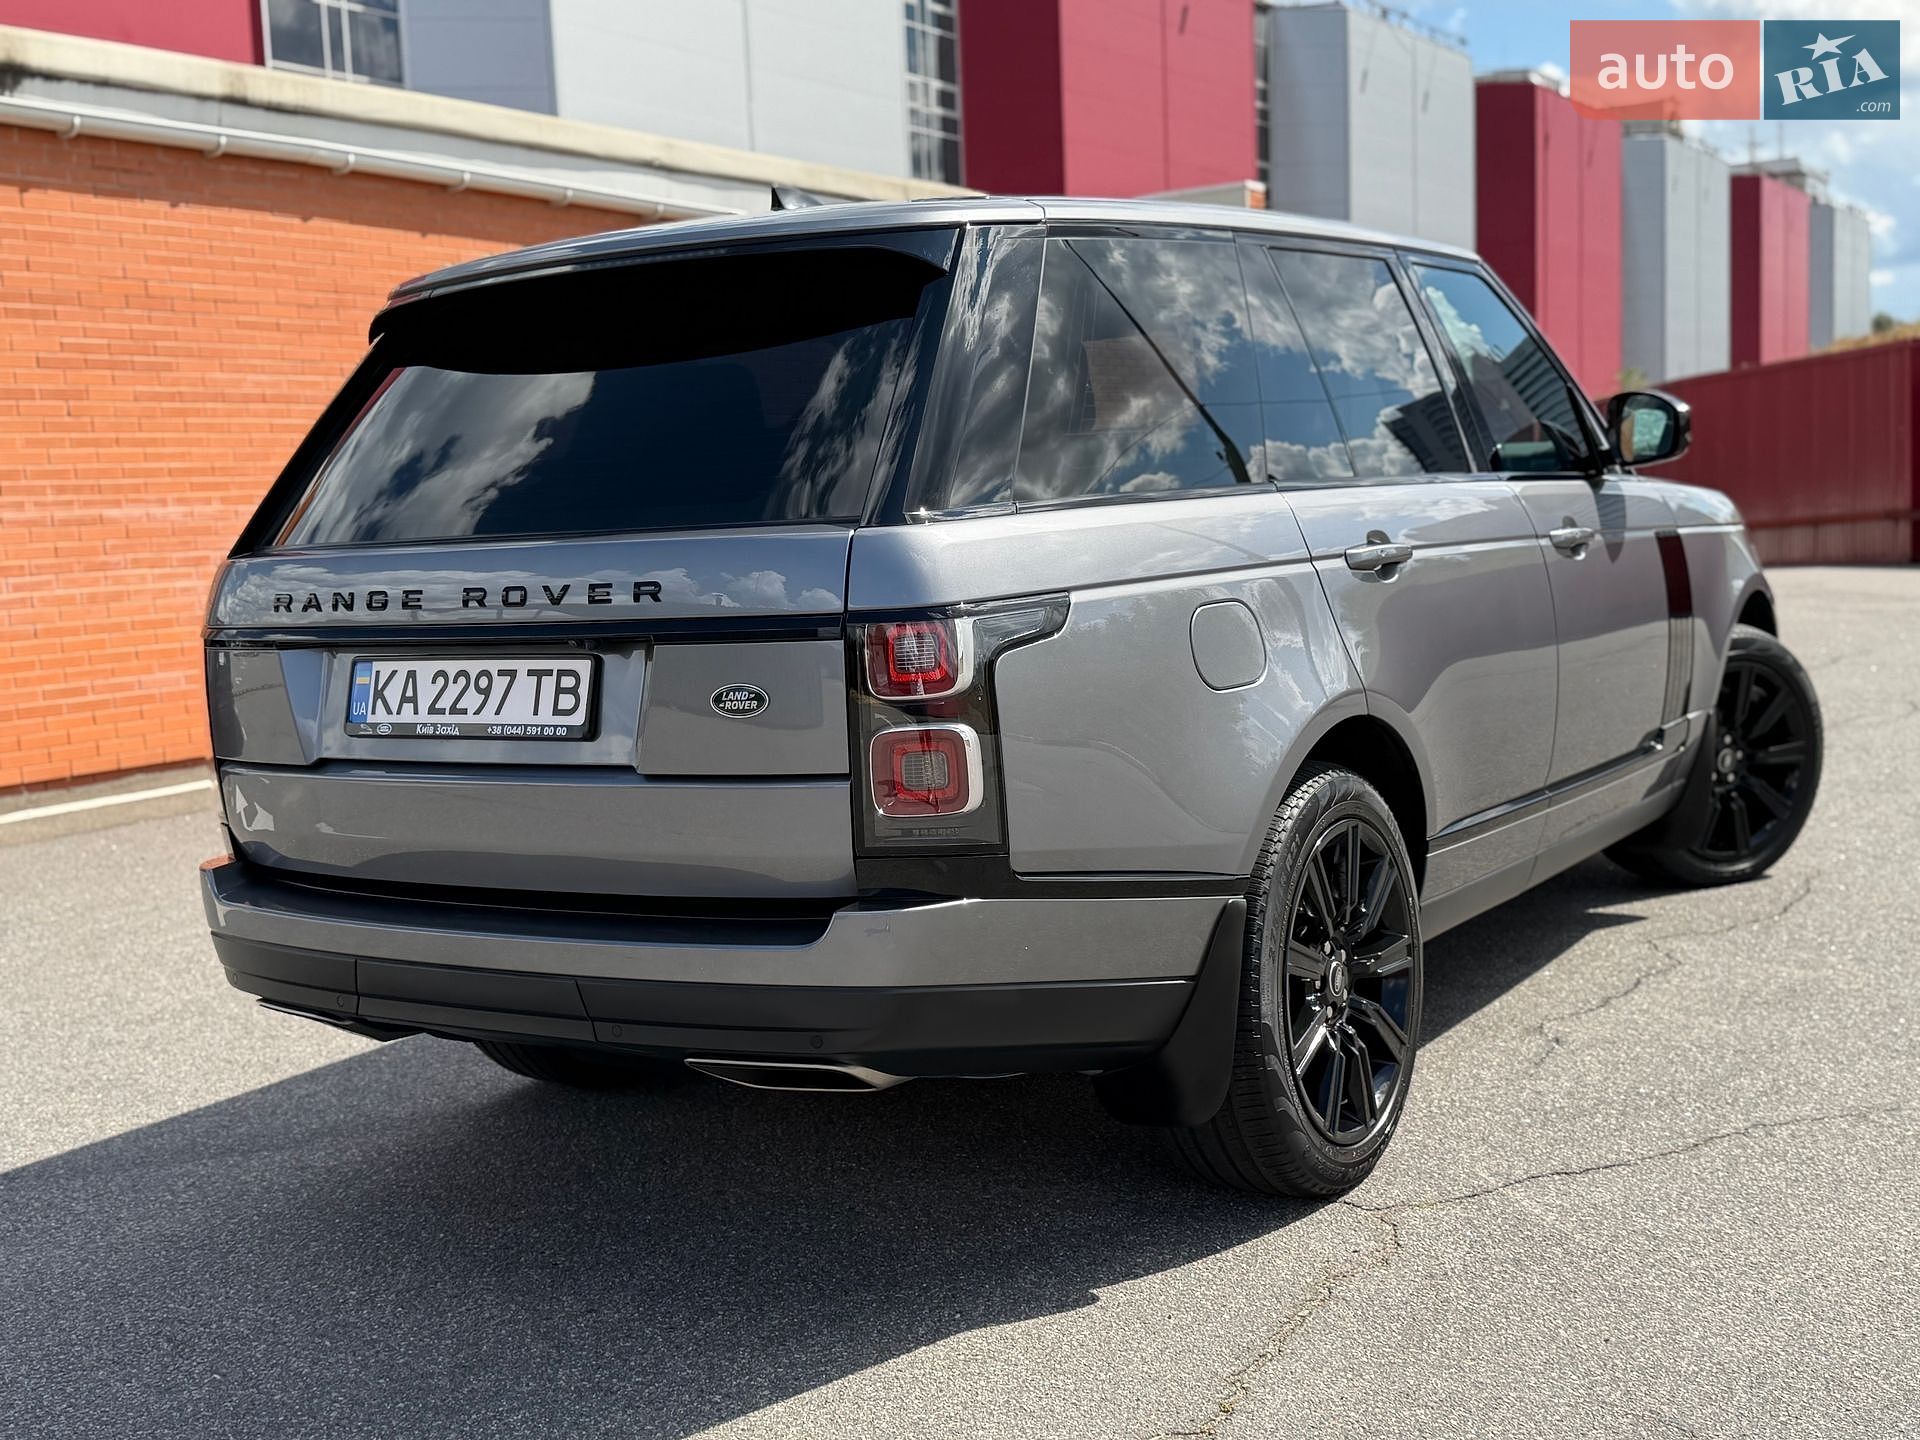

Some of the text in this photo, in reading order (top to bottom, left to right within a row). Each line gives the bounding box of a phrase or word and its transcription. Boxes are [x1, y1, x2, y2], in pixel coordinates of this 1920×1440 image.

[273, 580, 662, 613] RANGE ROVER
[371, 669, 581, 717] KA 2297 TB
[722, 691, 749, 700] LAND
[353, 702, 367, 716] UA
[724, 701, 758, 710] ROVER
[416, 724, 434, 735] Київ
[487, 725, 567, 736] +38 (044) 591 00 00
